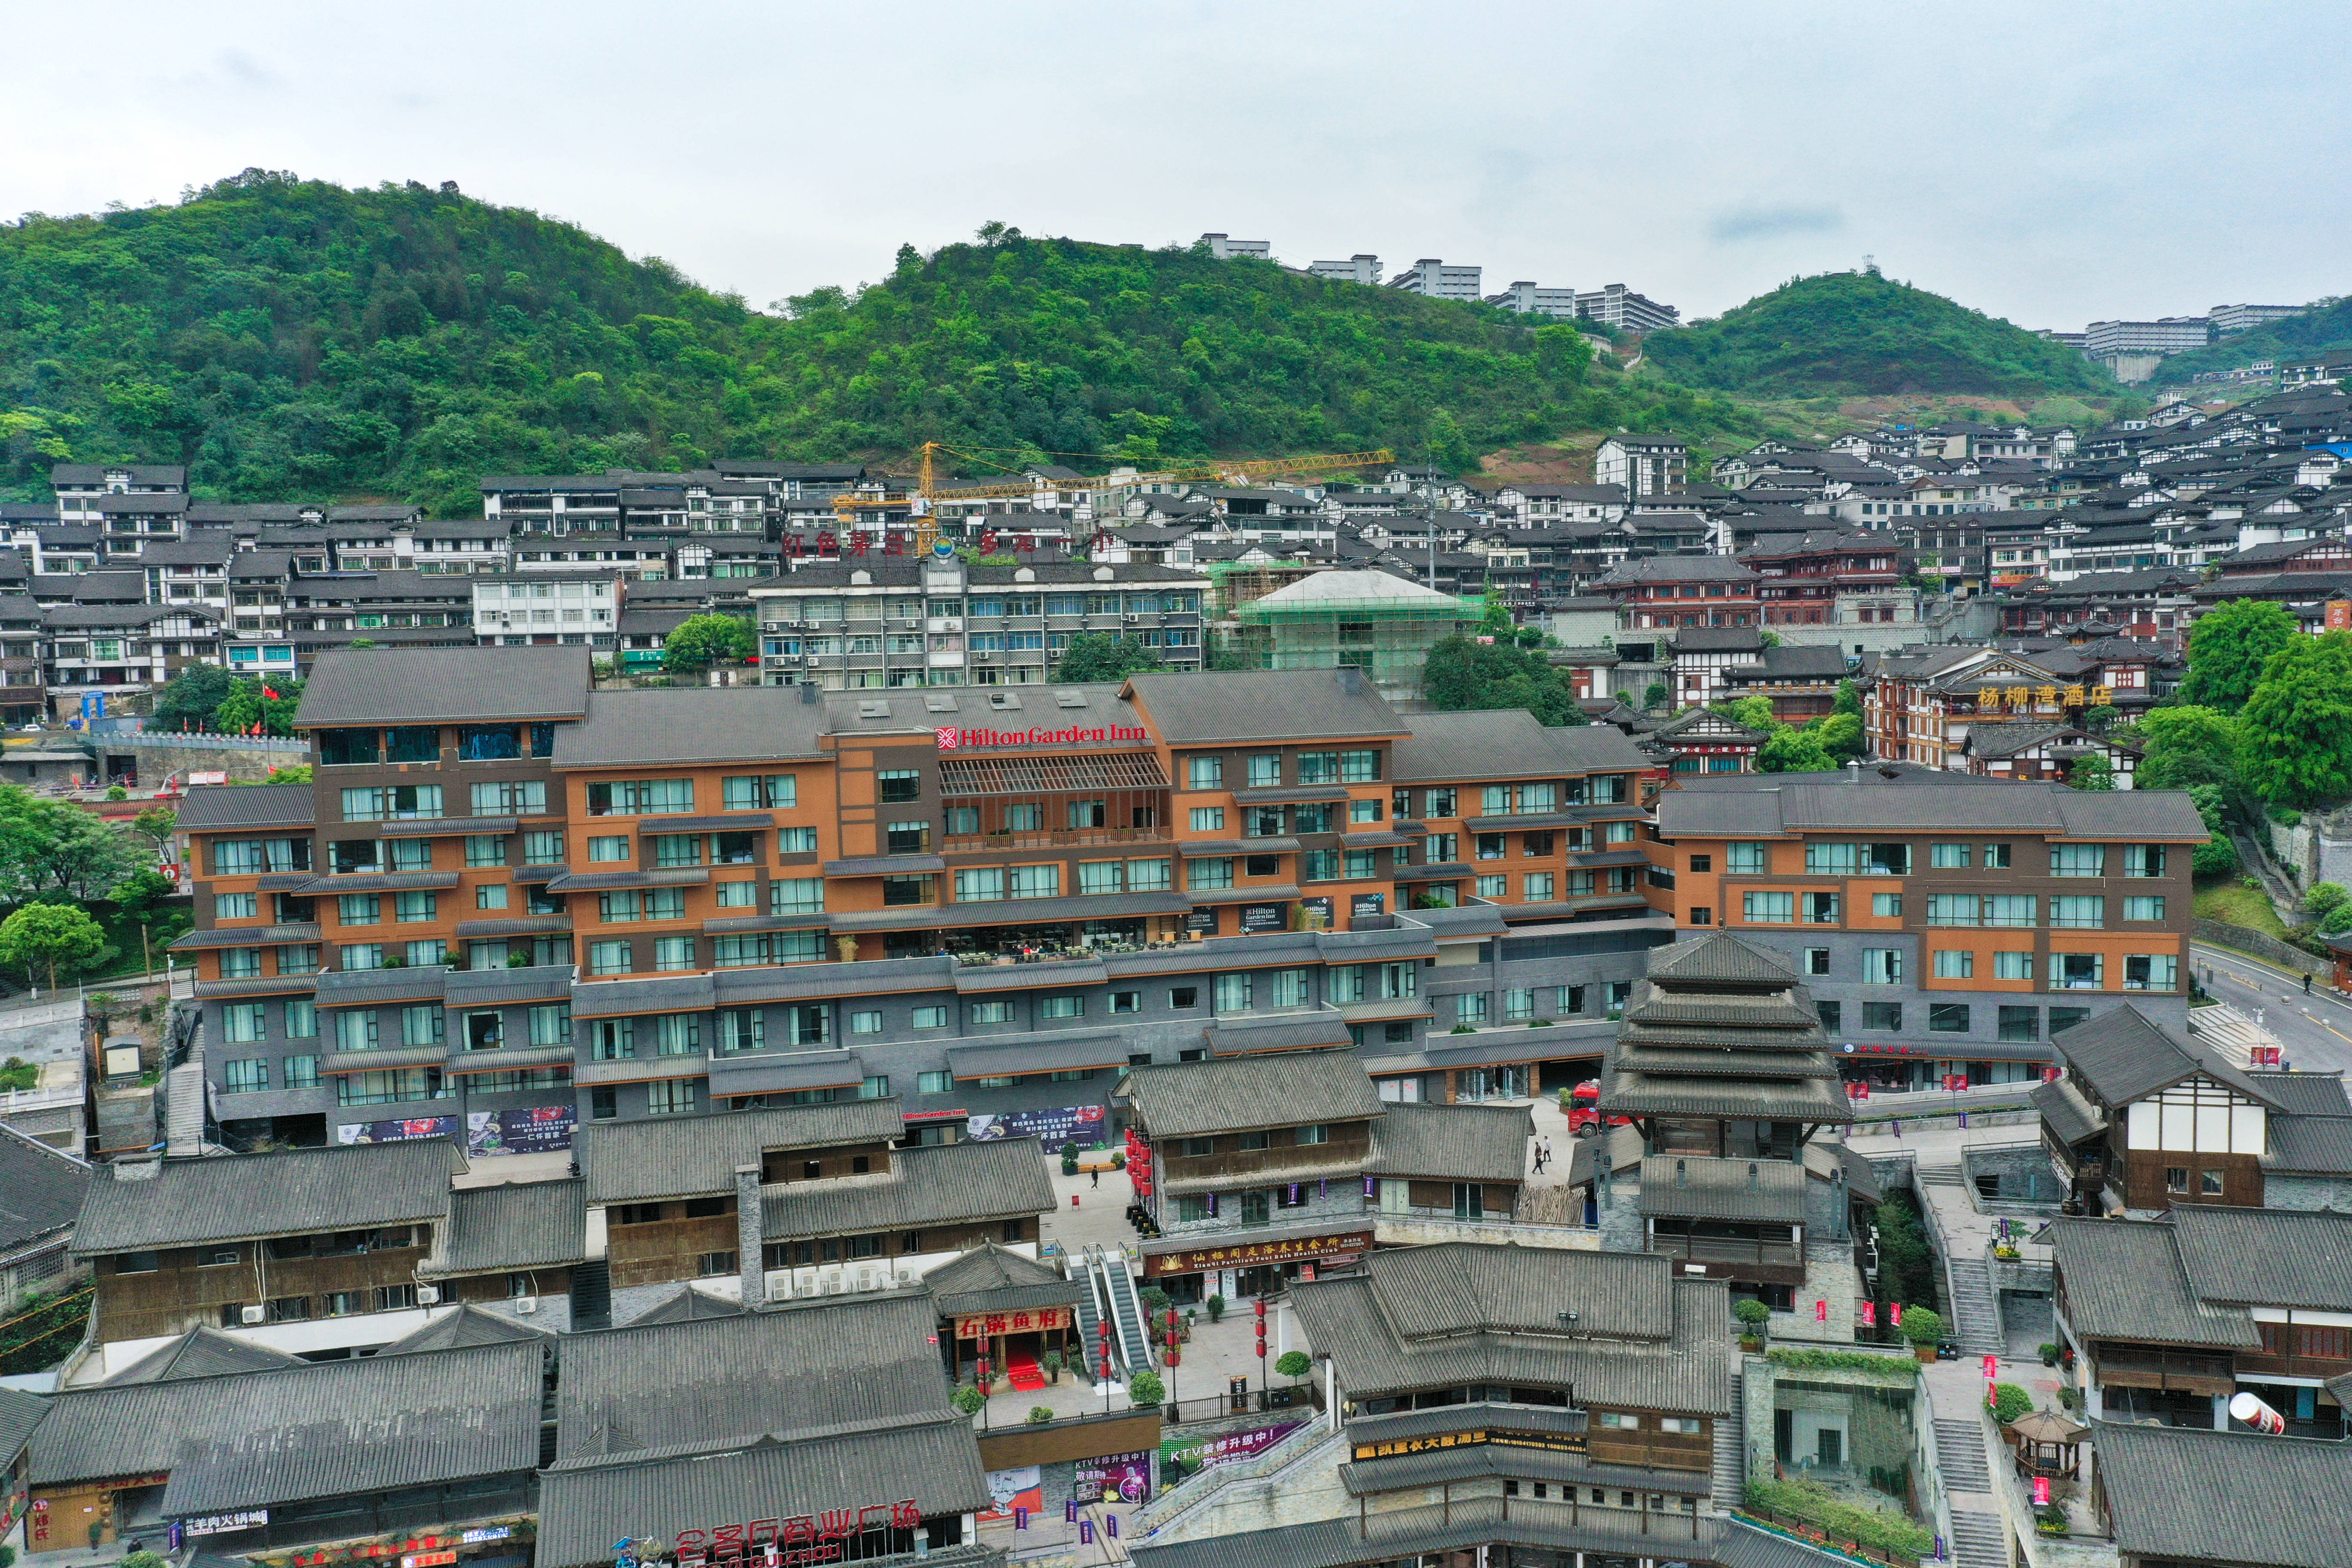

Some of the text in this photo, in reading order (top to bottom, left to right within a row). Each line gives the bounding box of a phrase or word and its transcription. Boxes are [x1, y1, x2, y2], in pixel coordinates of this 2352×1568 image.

[782, 530, 904, 557] 红色茅台
[1978, 684, 2113, 707] 杨柳湾酒店
[961, 724, 1146, 747] Hilton Garden Inn
[527, 1131, 560, 1141] 仁怀首家
[1222, 1258, 1253, 1266] Pavilion
[959, 1308, 1059, 1336] 石锅鱼府
[194, 1511, 262, 1530] 羊肉火锅城
[750, 1542, 840, 1568] GUIZHOU
